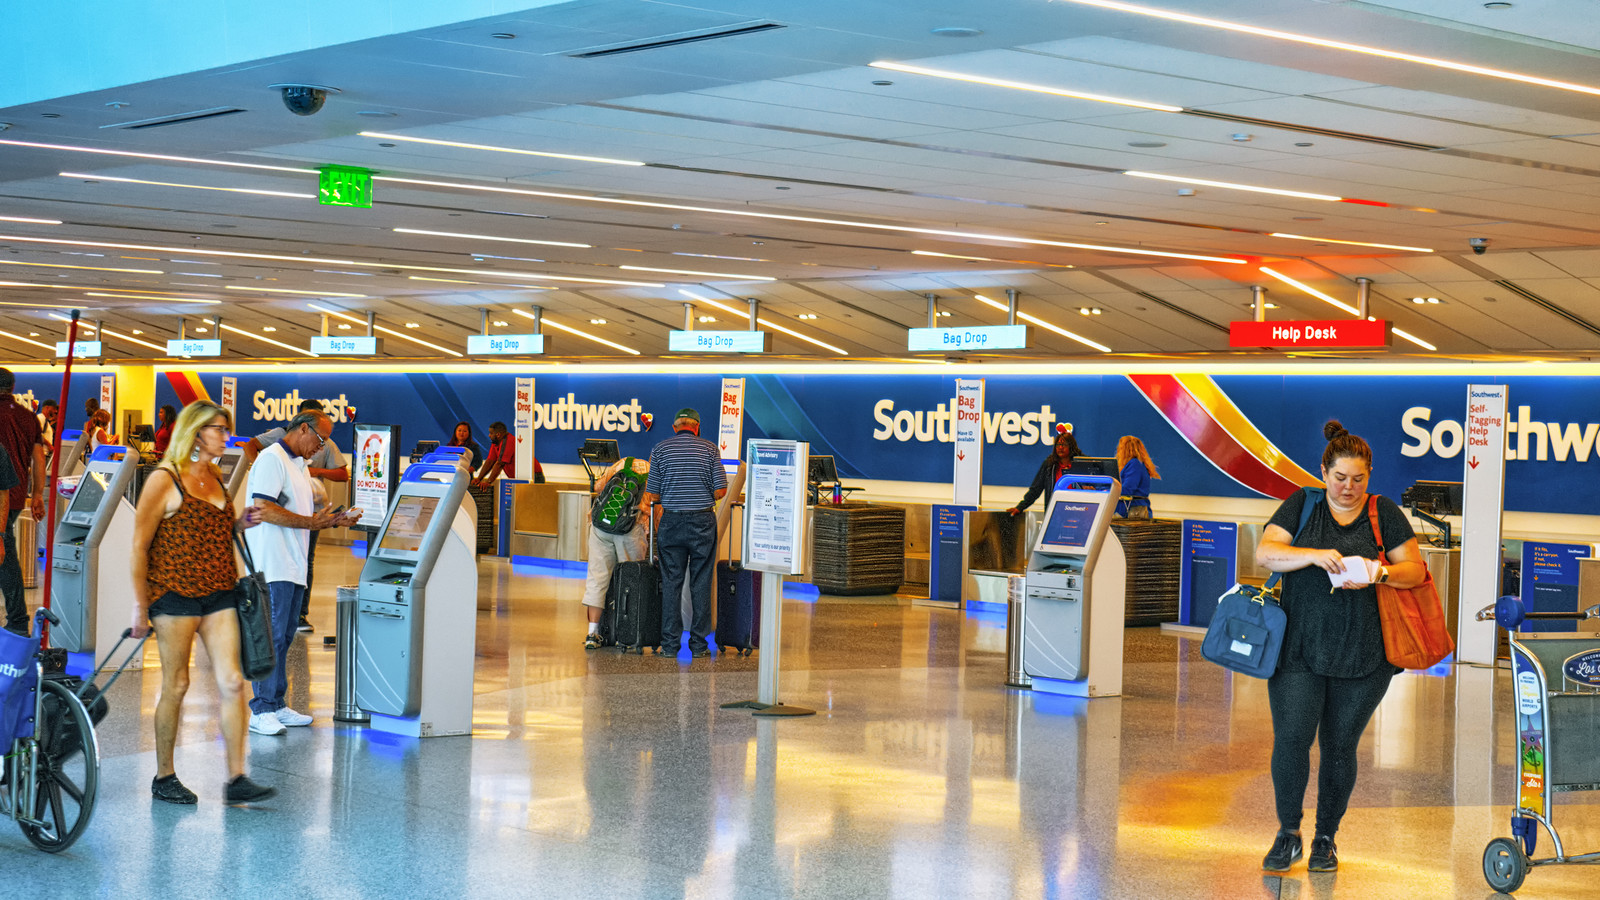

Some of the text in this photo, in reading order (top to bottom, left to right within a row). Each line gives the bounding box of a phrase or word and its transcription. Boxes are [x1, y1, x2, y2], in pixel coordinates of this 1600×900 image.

[330, 171, 369, 204] EXIT
[943, 332, 988, 347] Bag Drop
[1272, 325, 1337, 343] Help Desk
[183, 343, 204, 353] Bag Drop
[330, 340, 355, 351] Bag Drop
[490, 339, 520, 351] Bag Drop
[697, 335, 734, 349] Bag Drop
[223, 387, 232, 397] Bag
[517, 390, 529, 402] Bag
[223, 397, 233, 407] Drop
[723, 392, 737, 405] Bag
[958, 395, 975, 409] Bag
[517, 402, 531, 414] Drop
[722, 405, 740, 418] Drop
[1470, 404, 1488, 413] Self-
[957, 409, 980, 424] Drop
[1470, 415, 1502, 427] Tagging
[1469, 426, 1489, 437] Help
[1469, 437, 1489, 446] Desk
[365, 481, 374, 489] NOT
[375, 481, 387, 490] PACK
[1575, 662, 1595, 677] Los
